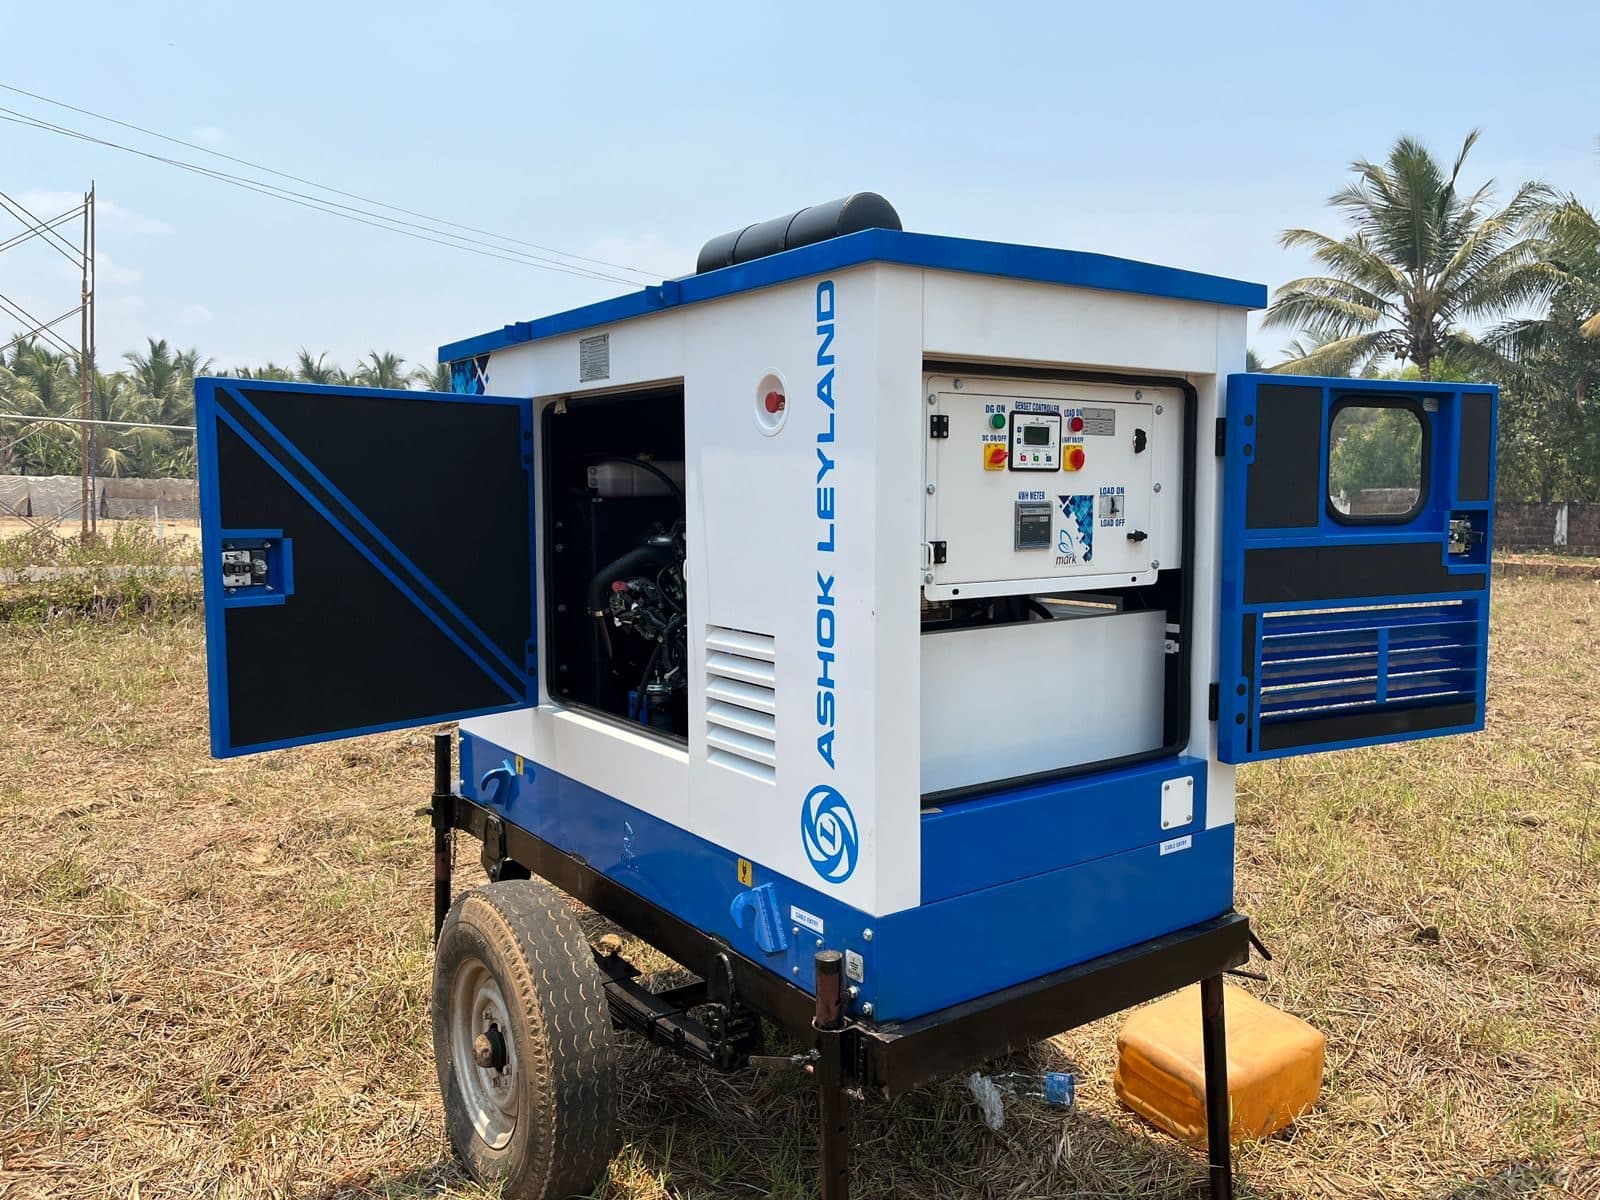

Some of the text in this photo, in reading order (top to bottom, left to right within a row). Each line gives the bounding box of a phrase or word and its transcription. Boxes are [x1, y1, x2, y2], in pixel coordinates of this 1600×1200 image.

[985, 405, 1006, 413] DG ON
[1099, 487, 1115, 495] LOAD
[816, 279, 835, 770] ASHOK LEYLAND
[1100, 519, 1126, 528] LOAD OFF
[1055, 554, 1077, 565] mark
